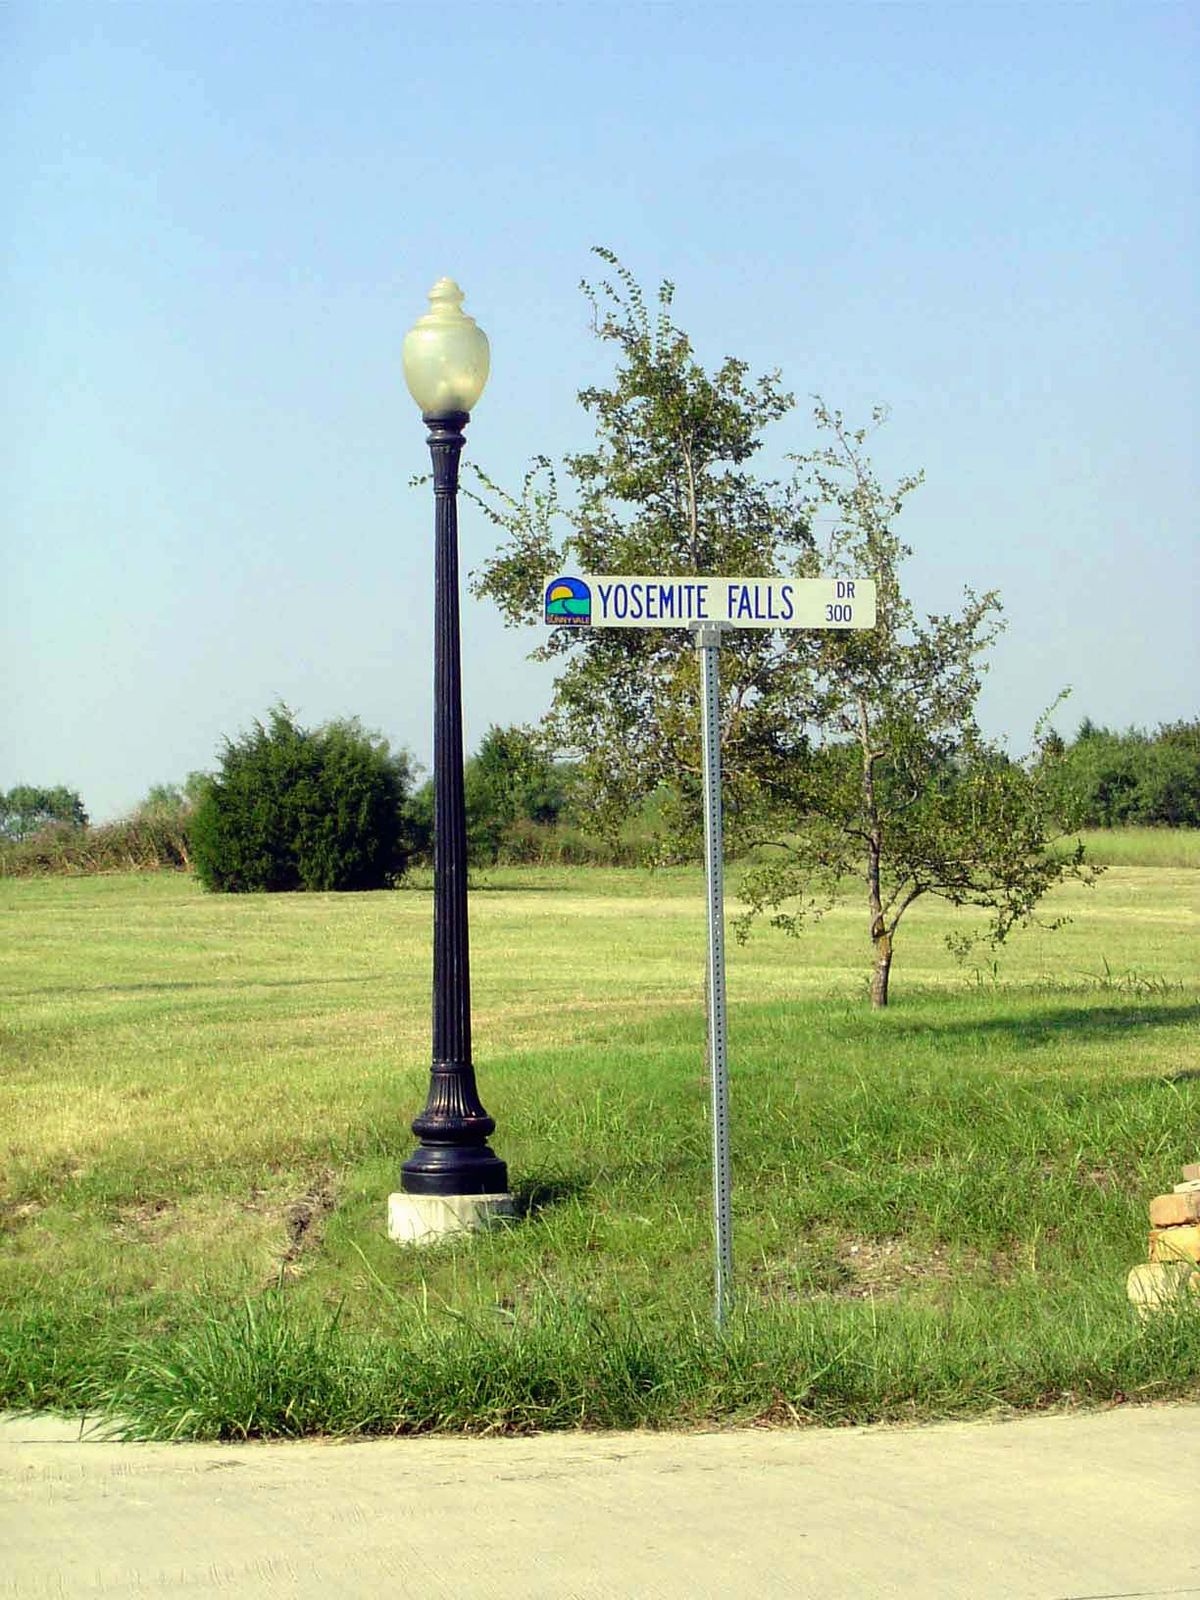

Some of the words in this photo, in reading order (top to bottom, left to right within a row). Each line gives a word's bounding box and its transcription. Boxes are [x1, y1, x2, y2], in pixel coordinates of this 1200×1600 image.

[836, 582, 855, 598] DR
[597, 584, 708, 618] YOSEMITE
[728, 585, 793, 619] FALLS
[826, 604, 852, 622] 300
